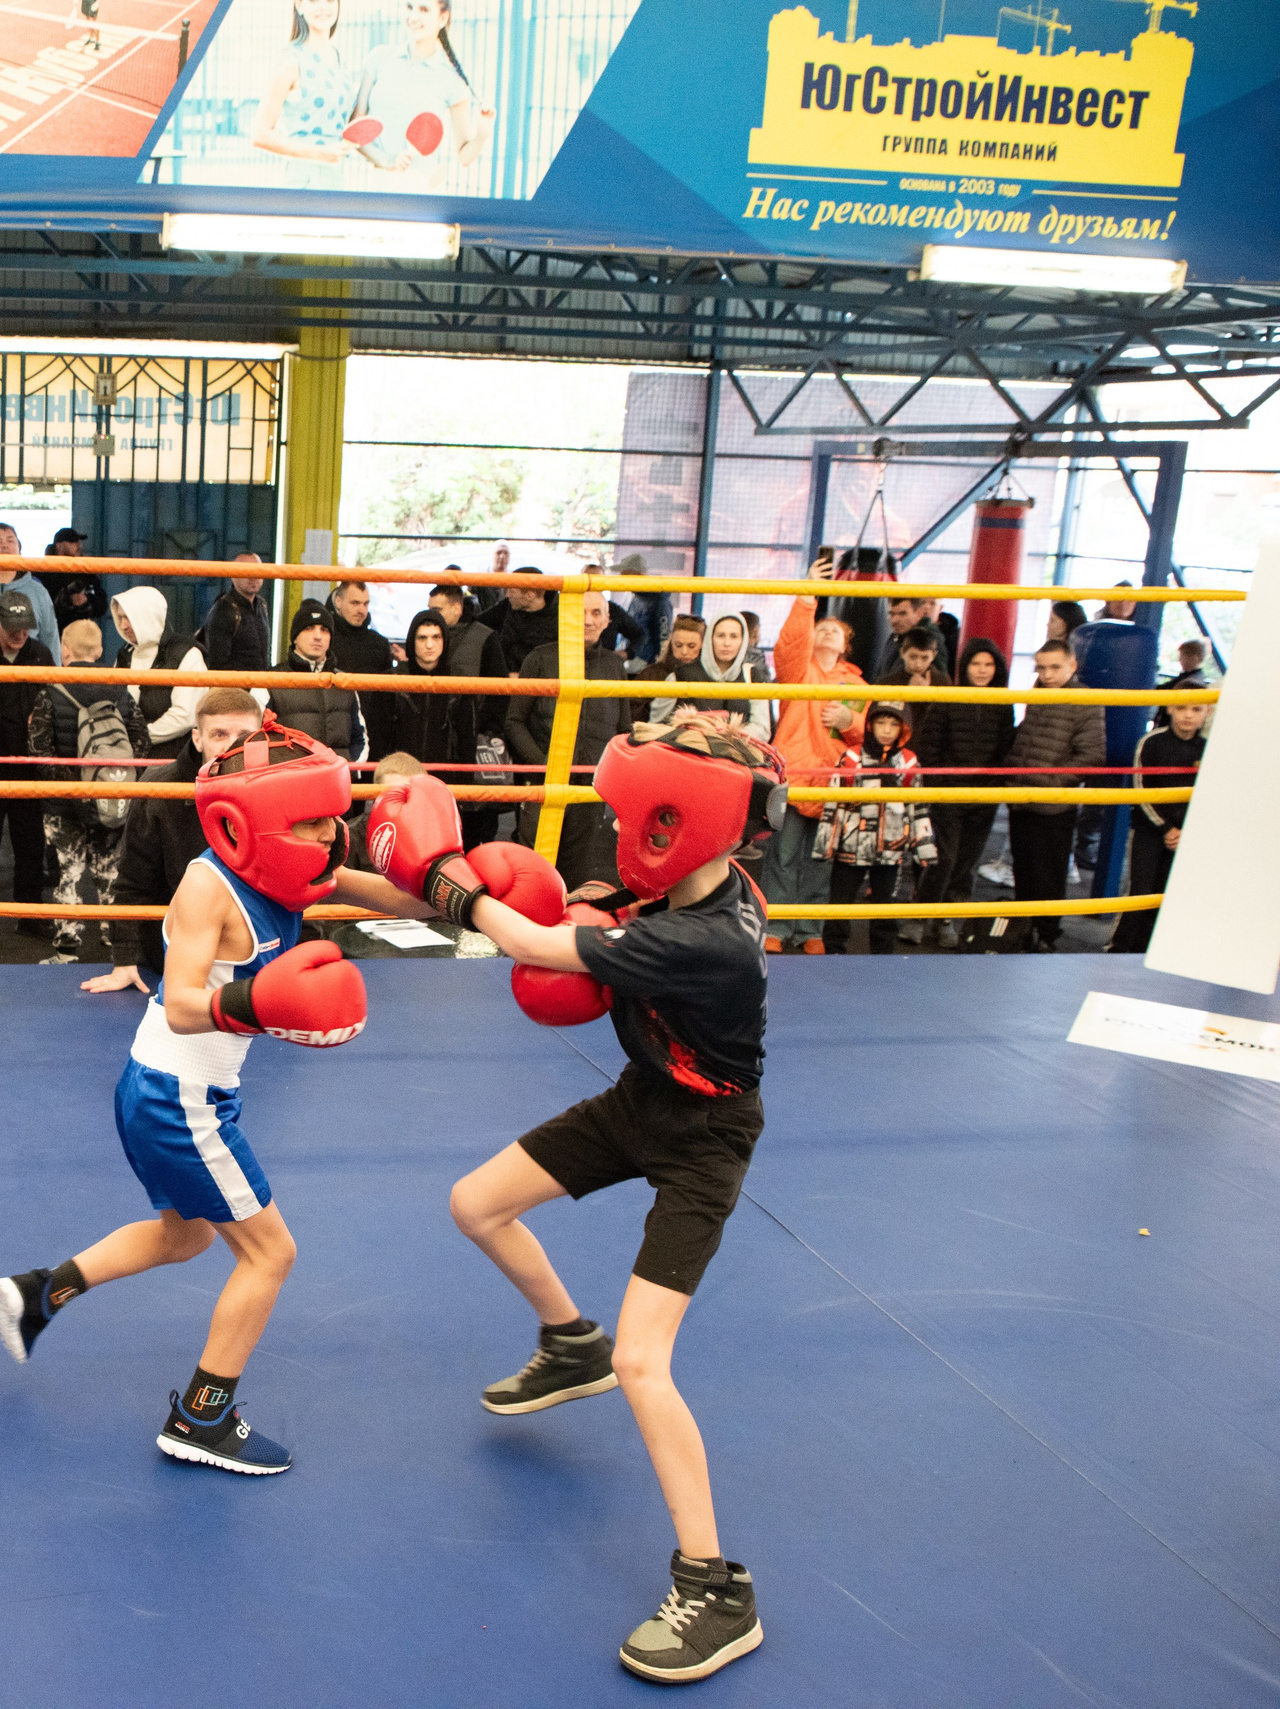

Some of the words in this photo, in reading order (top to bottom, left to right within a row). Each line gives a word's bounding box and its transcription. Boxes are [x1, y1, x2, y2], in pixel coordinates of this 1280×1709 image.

[799, 62, 1150, 130] ЮгСтройИнвест
[882, 135, 948, 157] ГРУППА
[959, 139, 1058, 162] КОМПАНИЙ
[958, 178, 995, 196] 2003
[742, 187, 809, 222] Нас
[812, 198, 1030, 239] рекомендуют
[1038, 203, 1177, 244] друзьям!
